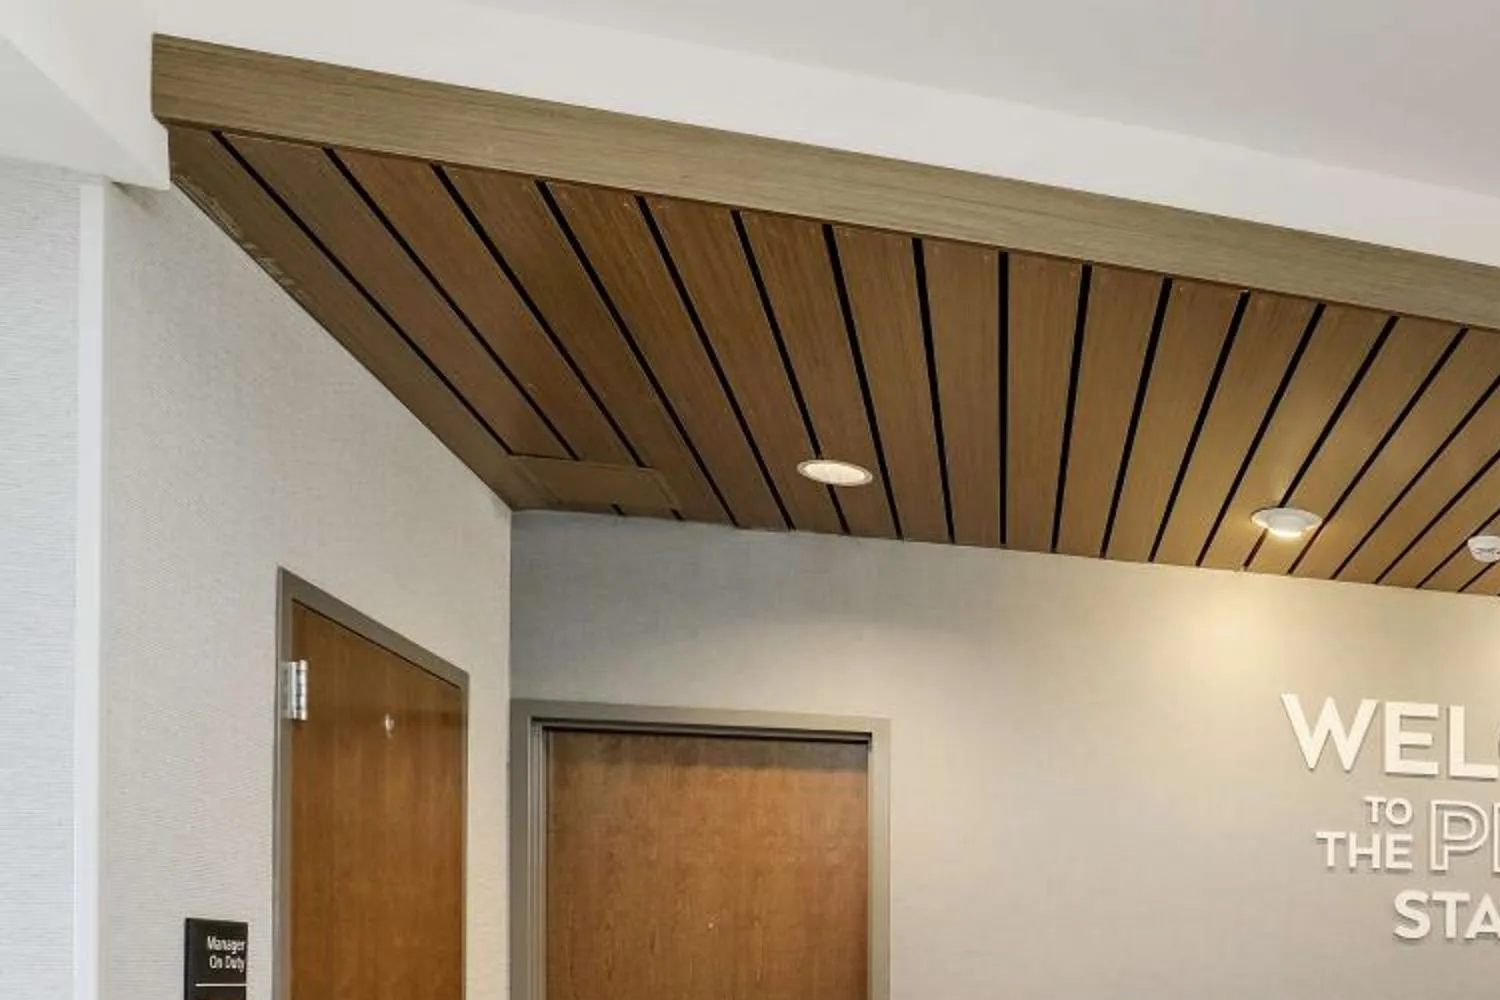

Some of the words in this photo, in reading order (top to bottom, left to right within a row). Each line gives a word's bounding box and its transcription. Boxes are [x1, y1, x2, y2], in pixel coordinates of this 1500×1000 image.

[1362, 796, 1414, 826] TO
[1315, 831, 1414, 870] THE
[207, 935, 245, 954] Manager
[209, 955, 223, 969] On
[225, 954, 245, 973] Duty
